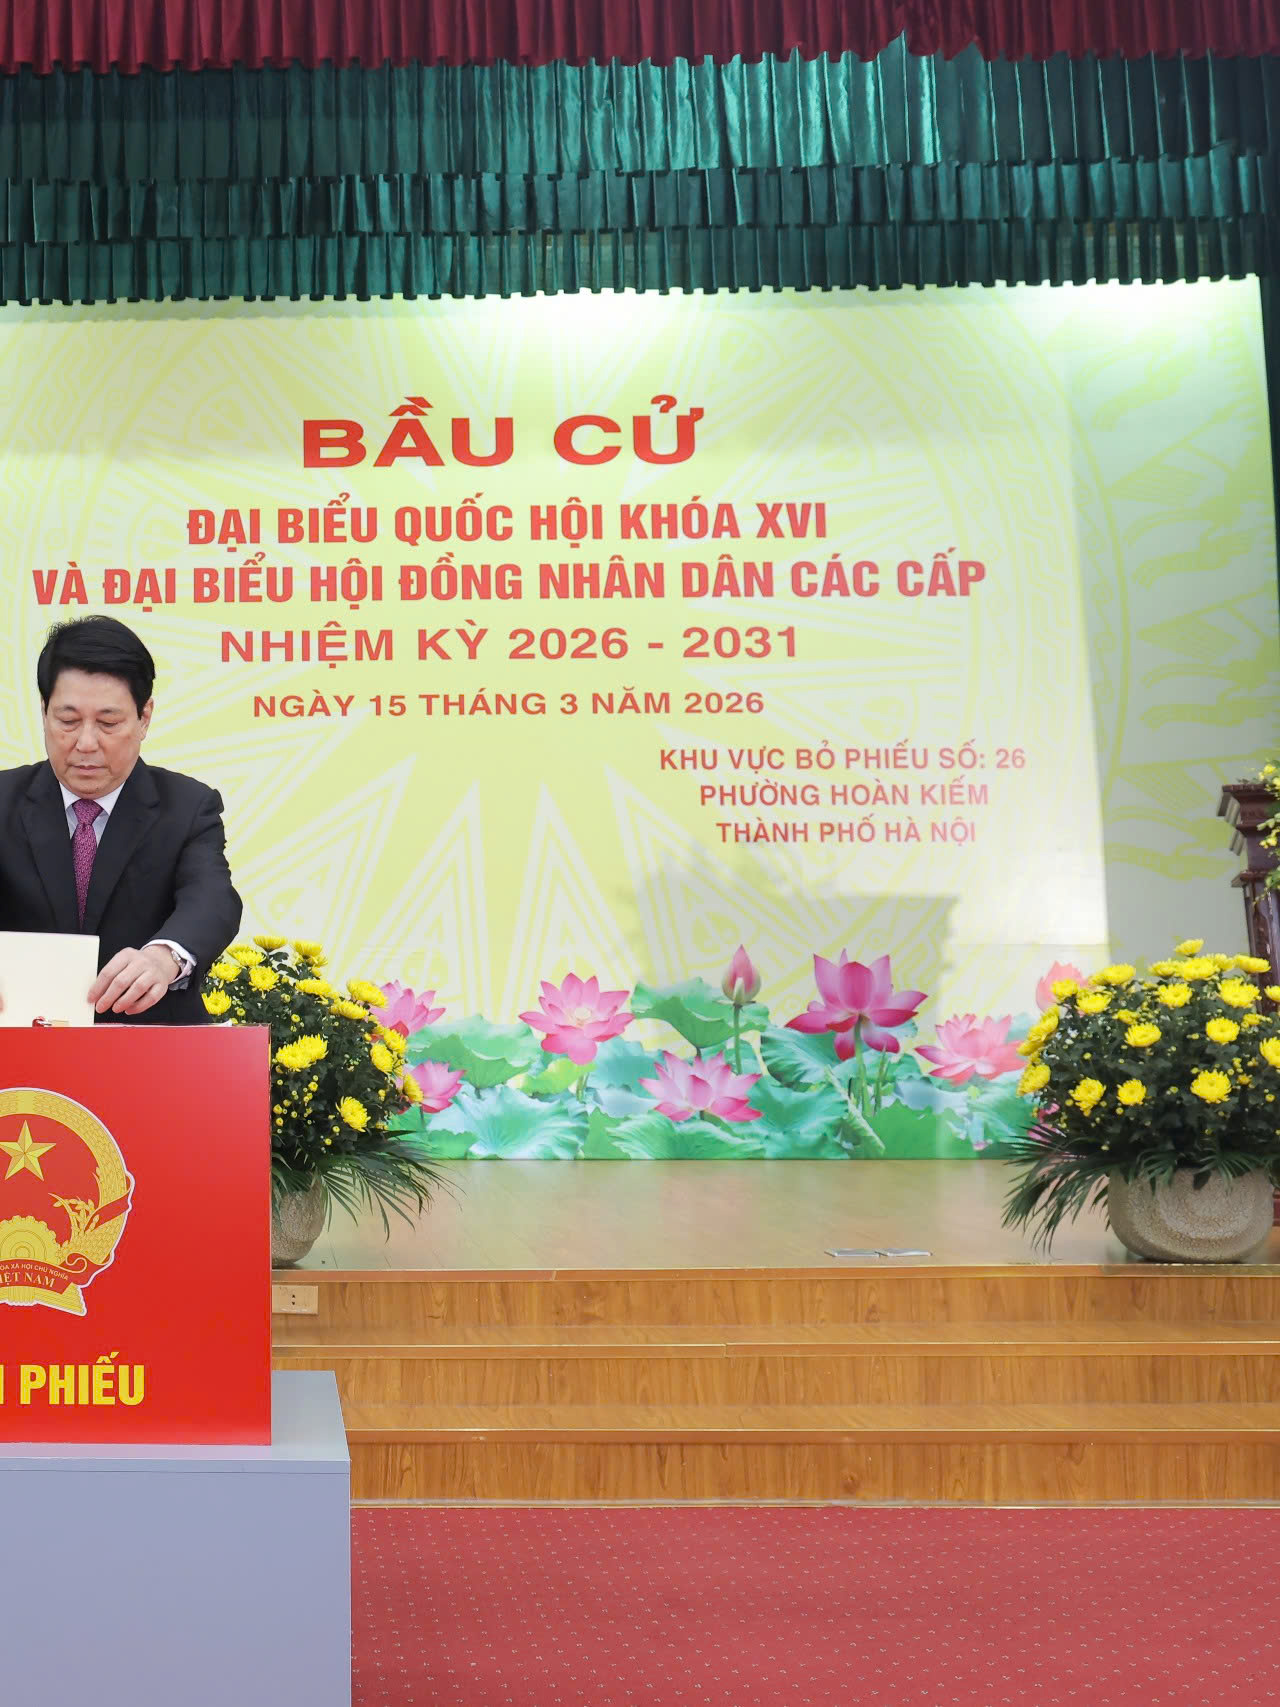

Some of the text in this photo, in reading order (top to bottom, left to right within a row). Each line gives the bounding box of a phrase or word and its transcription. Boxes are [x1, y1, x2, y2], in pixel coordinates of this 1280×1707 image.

[303, 394, 705, 469] BẦU CỬ
[186, 492, 827, 553] ĐẠI BIỂU QUỐC HỘI KHÓA XVI
[32, 547, 986, 613] VÀ ĐẠI BIỂU HỘI ĐỒNG NHÂN DÂN CÁC CẤP
[219, 620, 393, 670] NHIỆM
[417, 619, 489, 661] KỲ
[508, 627, 629, 660] 2026
[683, 625, 797, 659] 2031
[253, 686, 764, 718] NGÀY 15 THÁNG 3 NĂM 2026
[660, 738, 1025, 774] KHU VỰC BỎ PHIẾU SỐ: 26
[700, 775, 989, 806] PHƯỜNG HOÀN KIẾM
[716, 814, 977, 847] THÀNH PHỐ HÀ NỘI
[24, 1271, 56, 1288] NAM
[19, 1351, 145, 1406] PHIẾU
